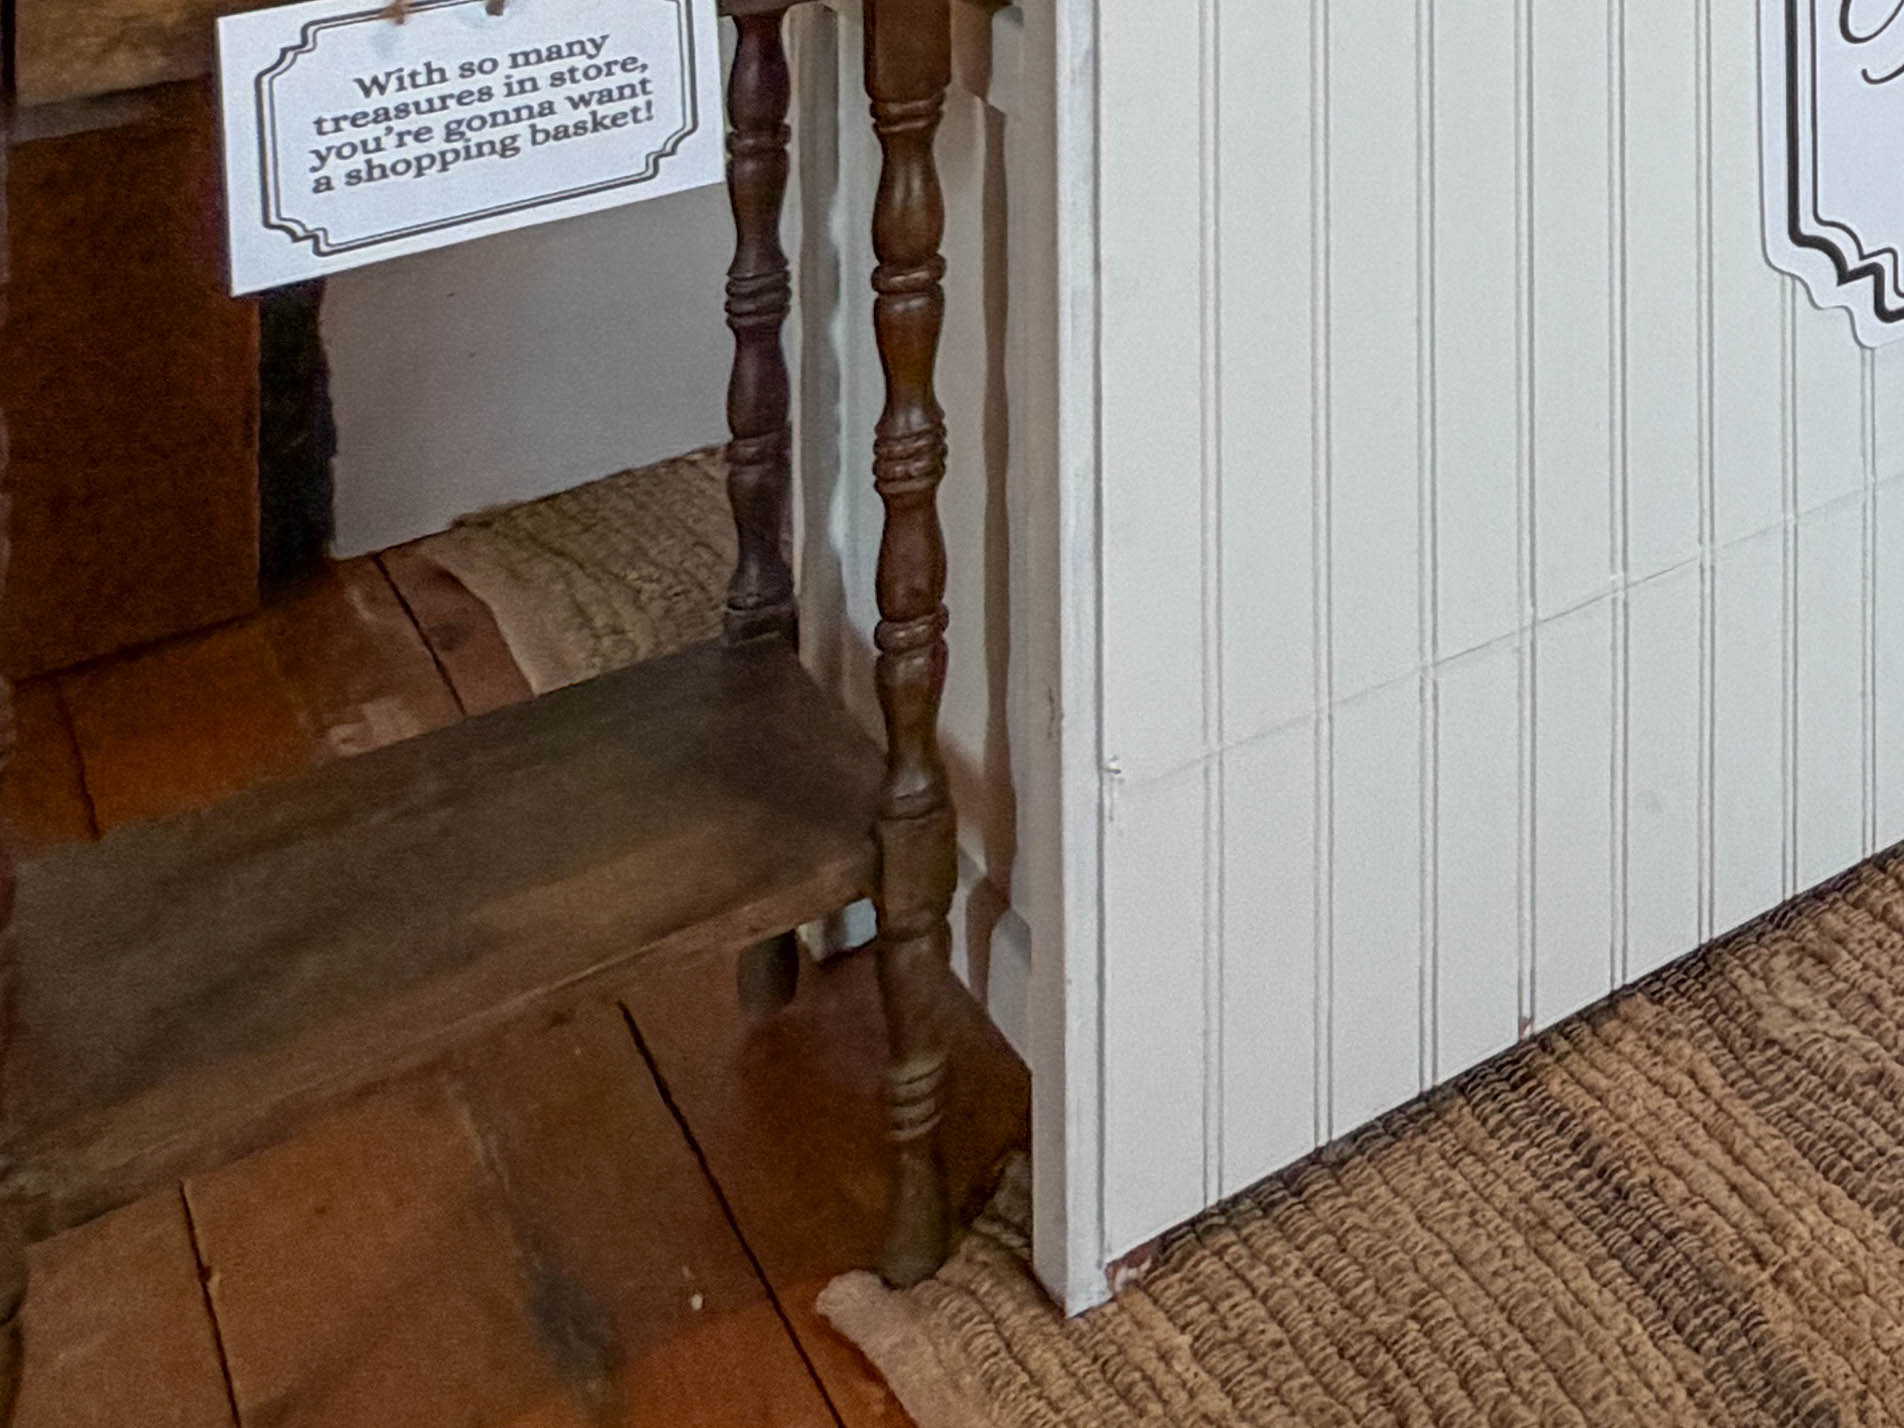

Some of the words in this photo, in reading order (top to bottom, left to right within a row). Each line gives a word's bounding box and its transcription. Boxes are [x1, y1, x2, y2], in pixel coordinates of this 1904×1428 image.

[313, 88, 494, 137] treasures
[503, 75, 538, 98] in
[550, 55, 649, 87] store,
[354, 62, 448, 99] With
[458, 57, 499, 79] so
[508, 34, 610, 70] many
[308, 124, 433, 173] you're
[444, 101, 556, 142] gonna
[565, 78, 654, 110] want
[311, 173, 334, 194] a
[343, 133, 521, 187] shopping
[530, 101, 655, 146] basket!
